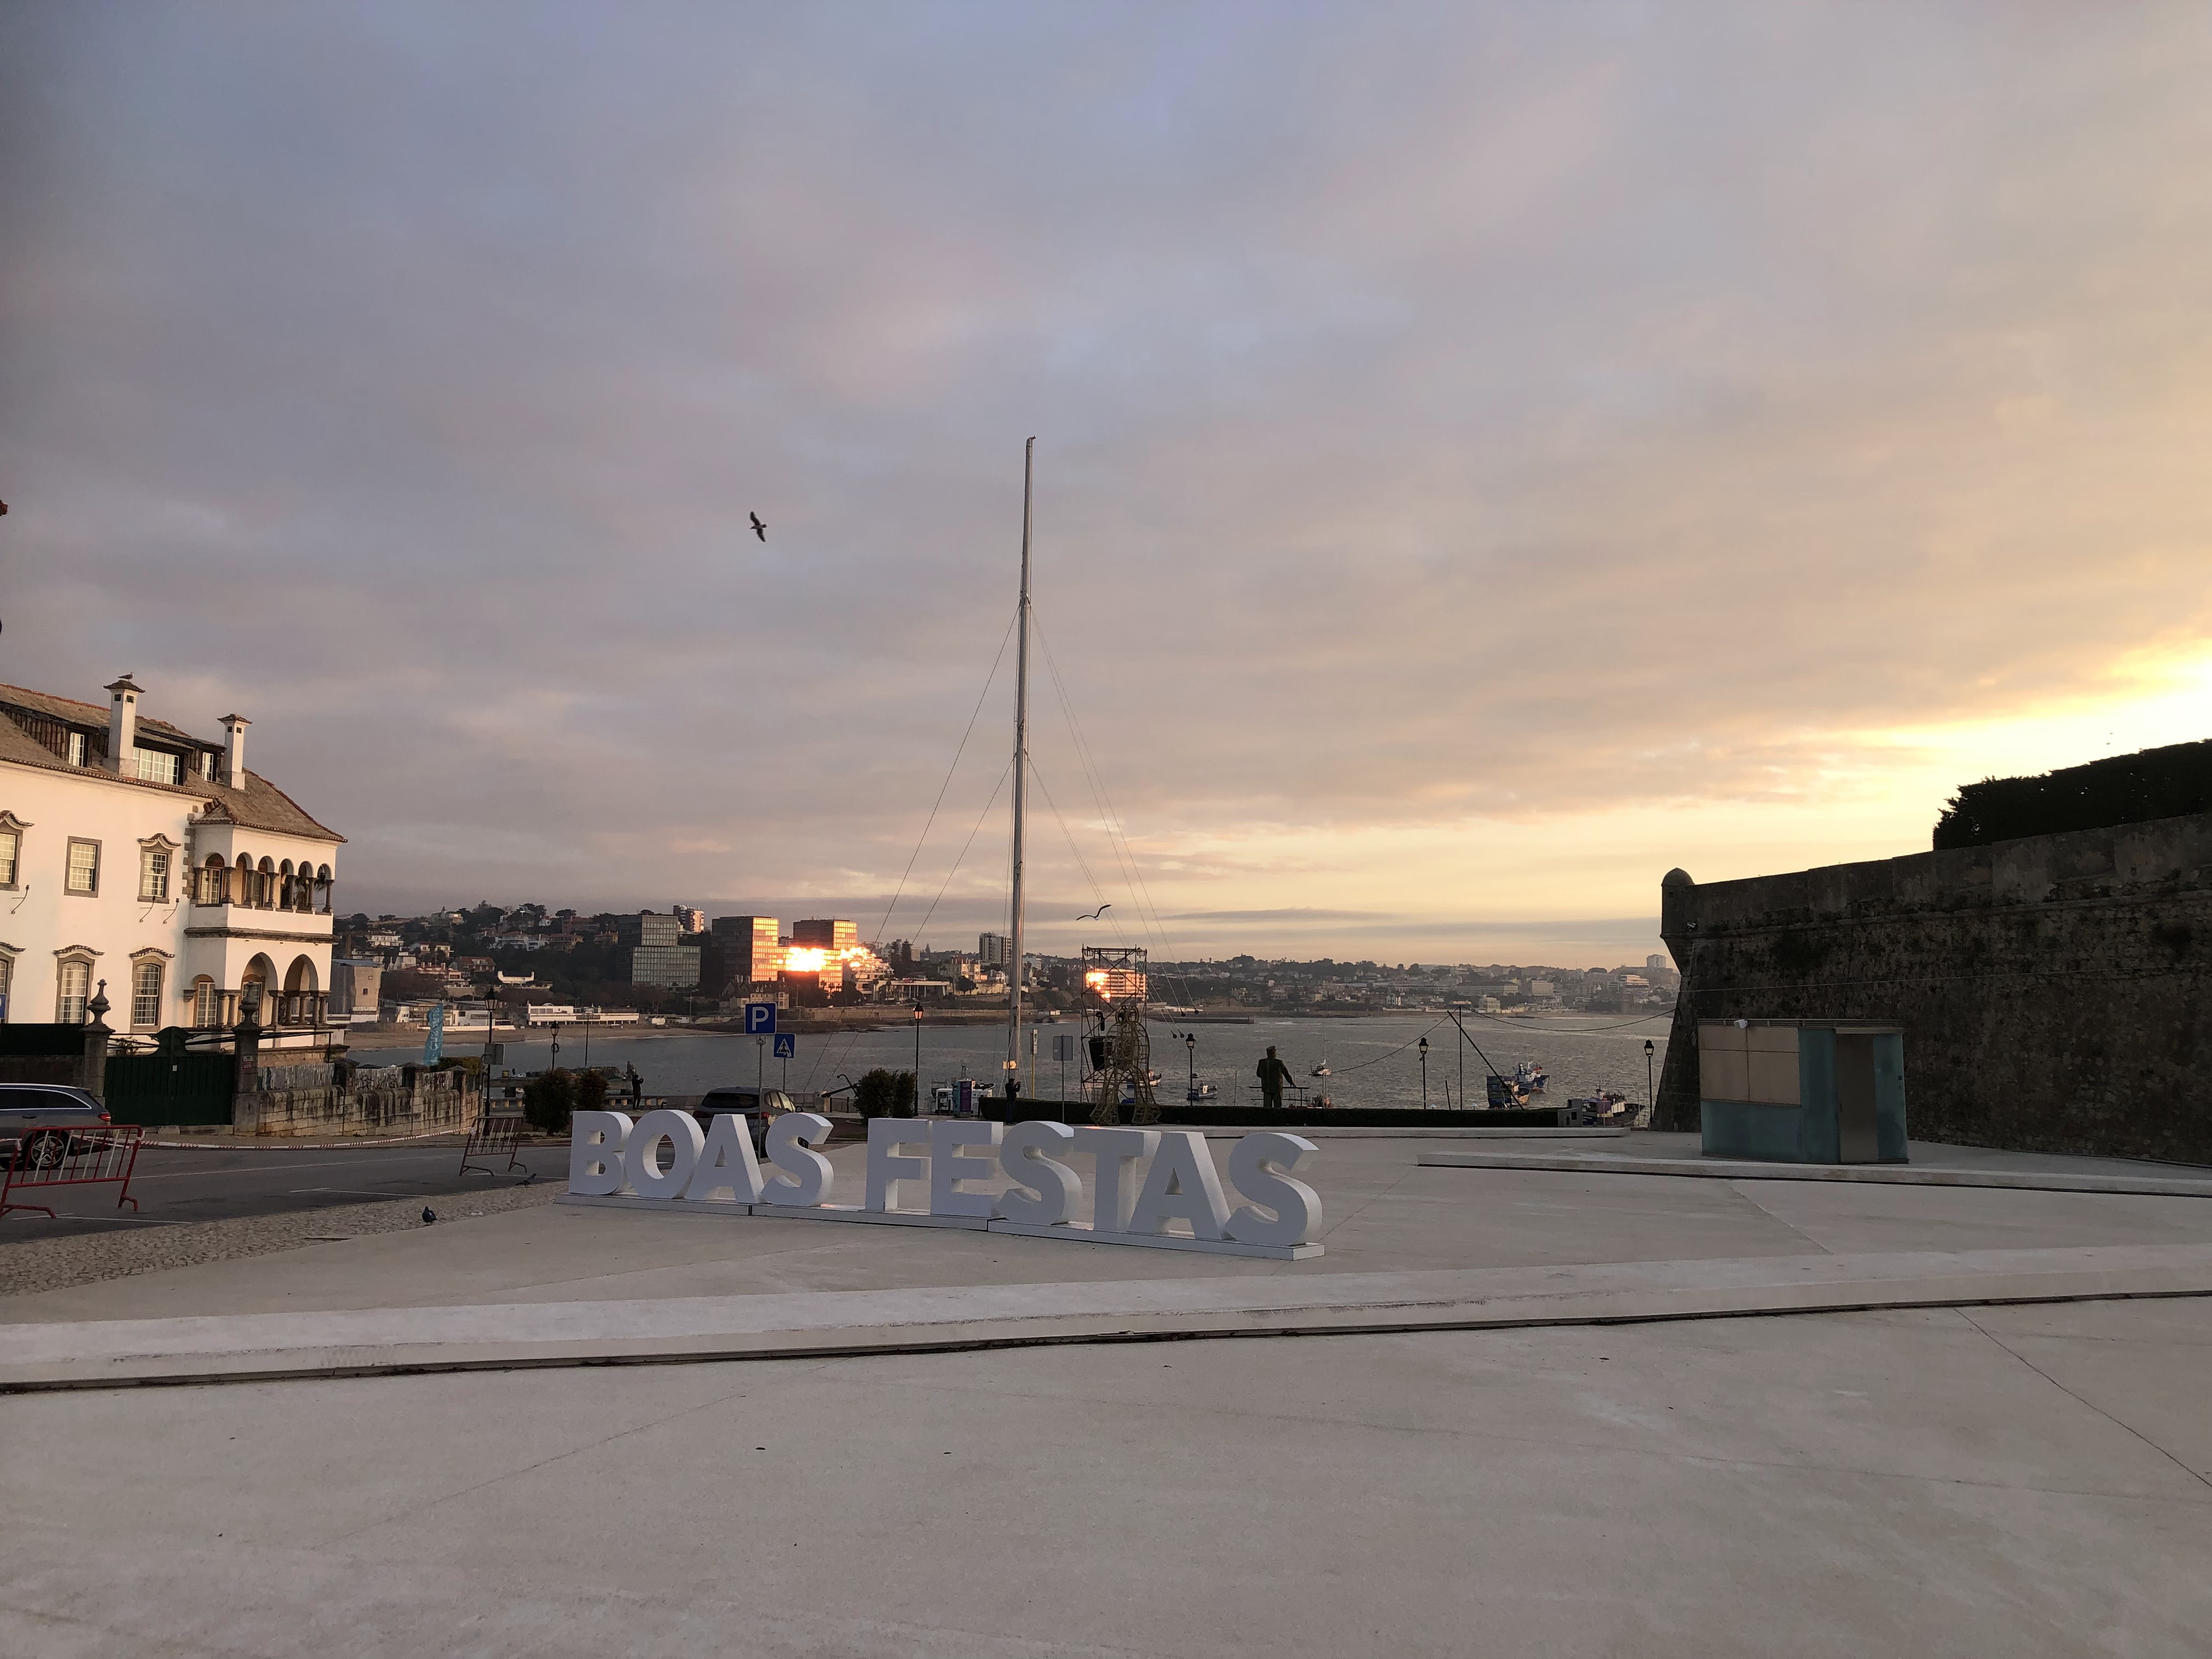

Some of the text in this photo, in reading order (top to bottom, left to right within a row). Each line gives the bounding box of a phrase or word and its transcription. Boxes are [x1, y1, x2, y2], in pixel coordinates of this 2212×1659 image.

[752, 1006, 769, 1031] P
[568, 1109, 1323, 1246] BOAS FESTAS
